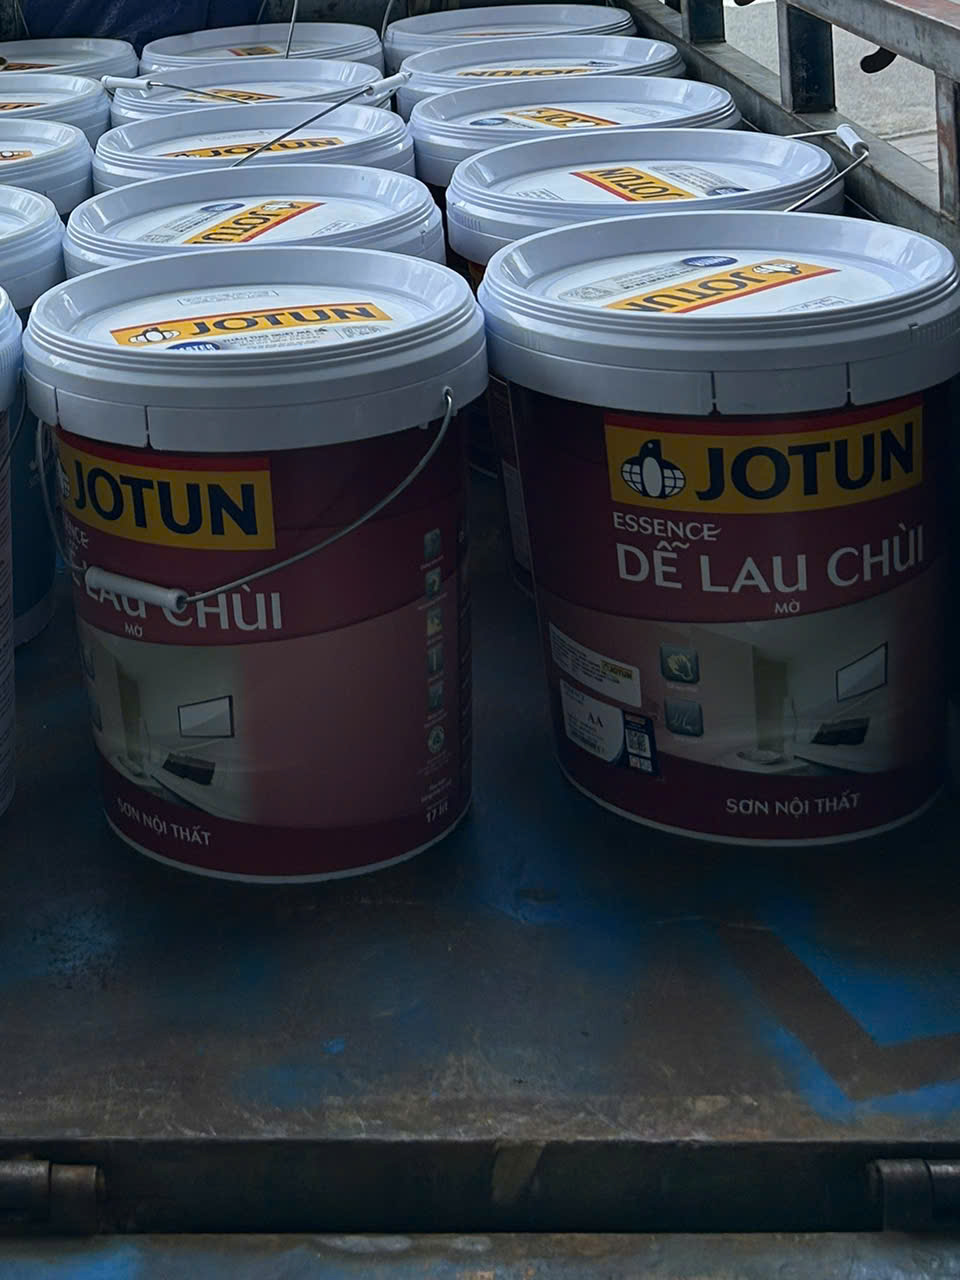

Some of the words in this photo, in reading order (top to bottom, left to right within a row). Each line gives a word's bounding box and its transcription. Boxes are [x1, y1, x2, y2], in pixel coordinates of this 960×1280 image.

[191, 306, 377, 336] JOTUN
[695, 422, 914, 502] JOTUN
[74, 459, 258, 536] JOTUN
[612, 511, 722, 542] ESSENCE
[615, 539, 691, 590] DỄ
[698, 554, 808, 594] LAU
[827, 521, 925, 588] CHÙI
[726, 797, 769, 816] SƠN
[775, 795, 809, 821] NỘI
[814, 789, 861, 815] THẤT
[142, 813, 168, 836] NỘI
[170, 824, 211, 847] THẤT
